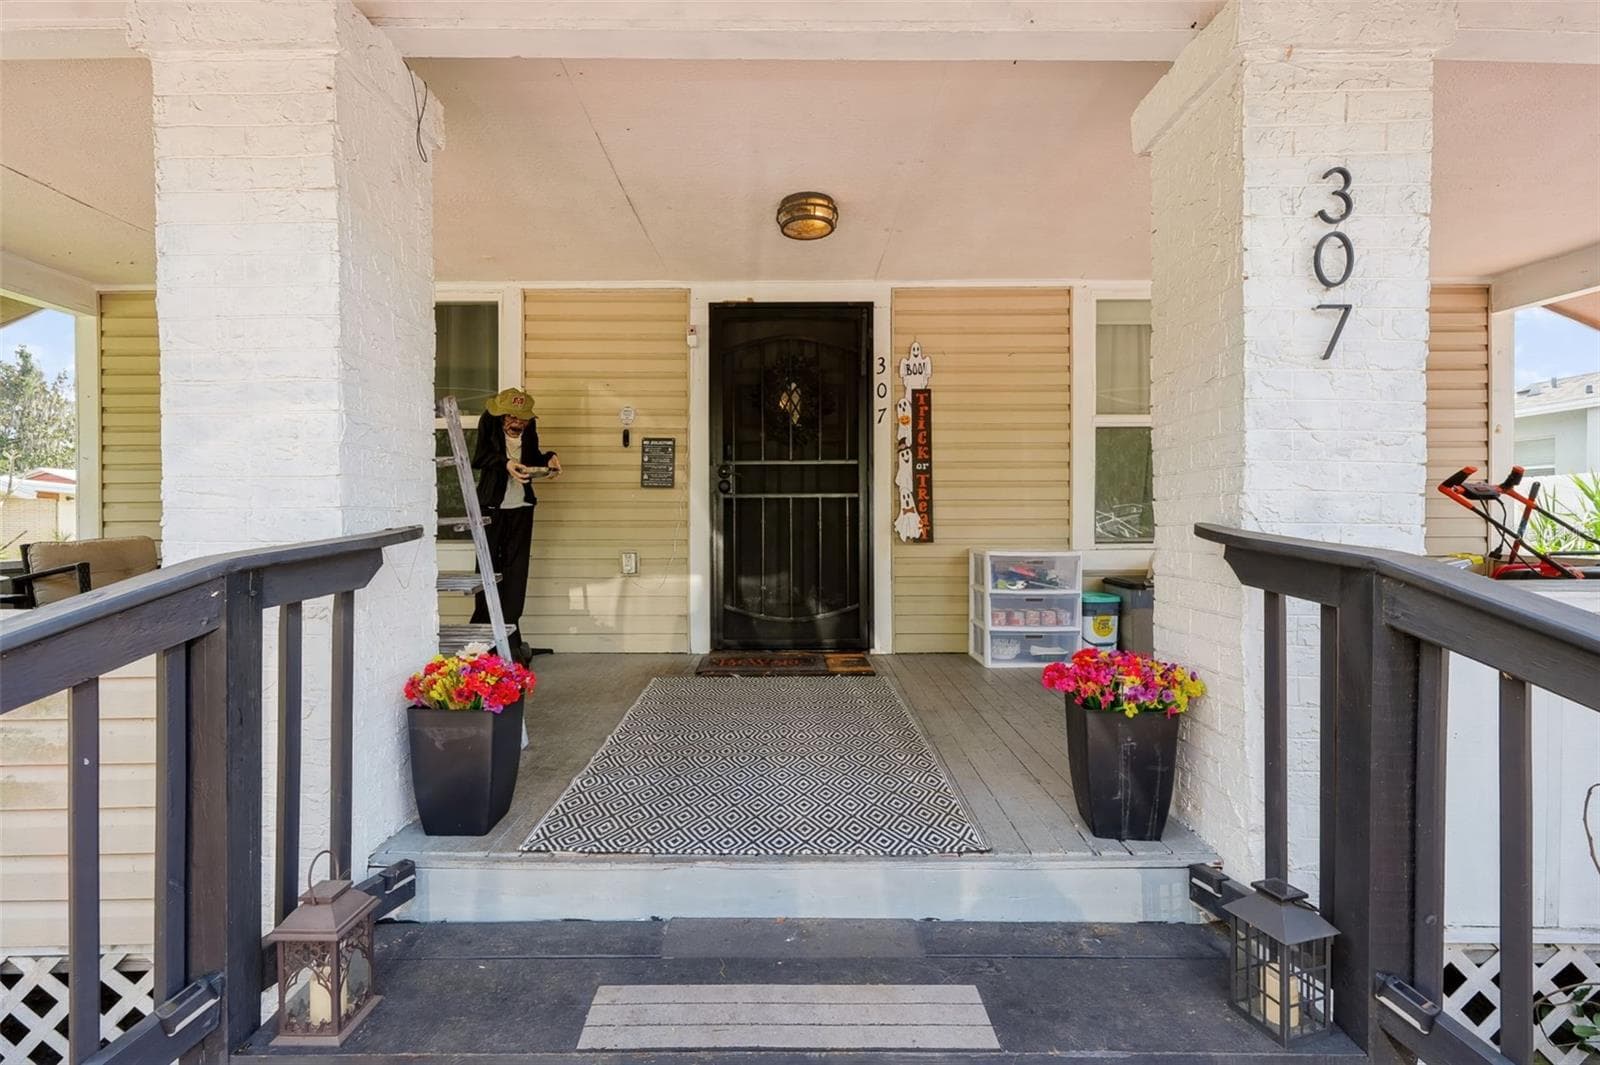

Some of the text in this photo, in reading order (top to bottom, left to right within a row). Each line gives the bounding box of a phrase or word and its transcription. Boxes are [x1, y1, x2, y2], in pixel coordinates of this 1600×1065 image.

[1313, 166, 1354, 360] 307
[905, 362, 926, 376] BOO!
[876, 356, 887, 424] 307
[916, 462, 929, 470] or
